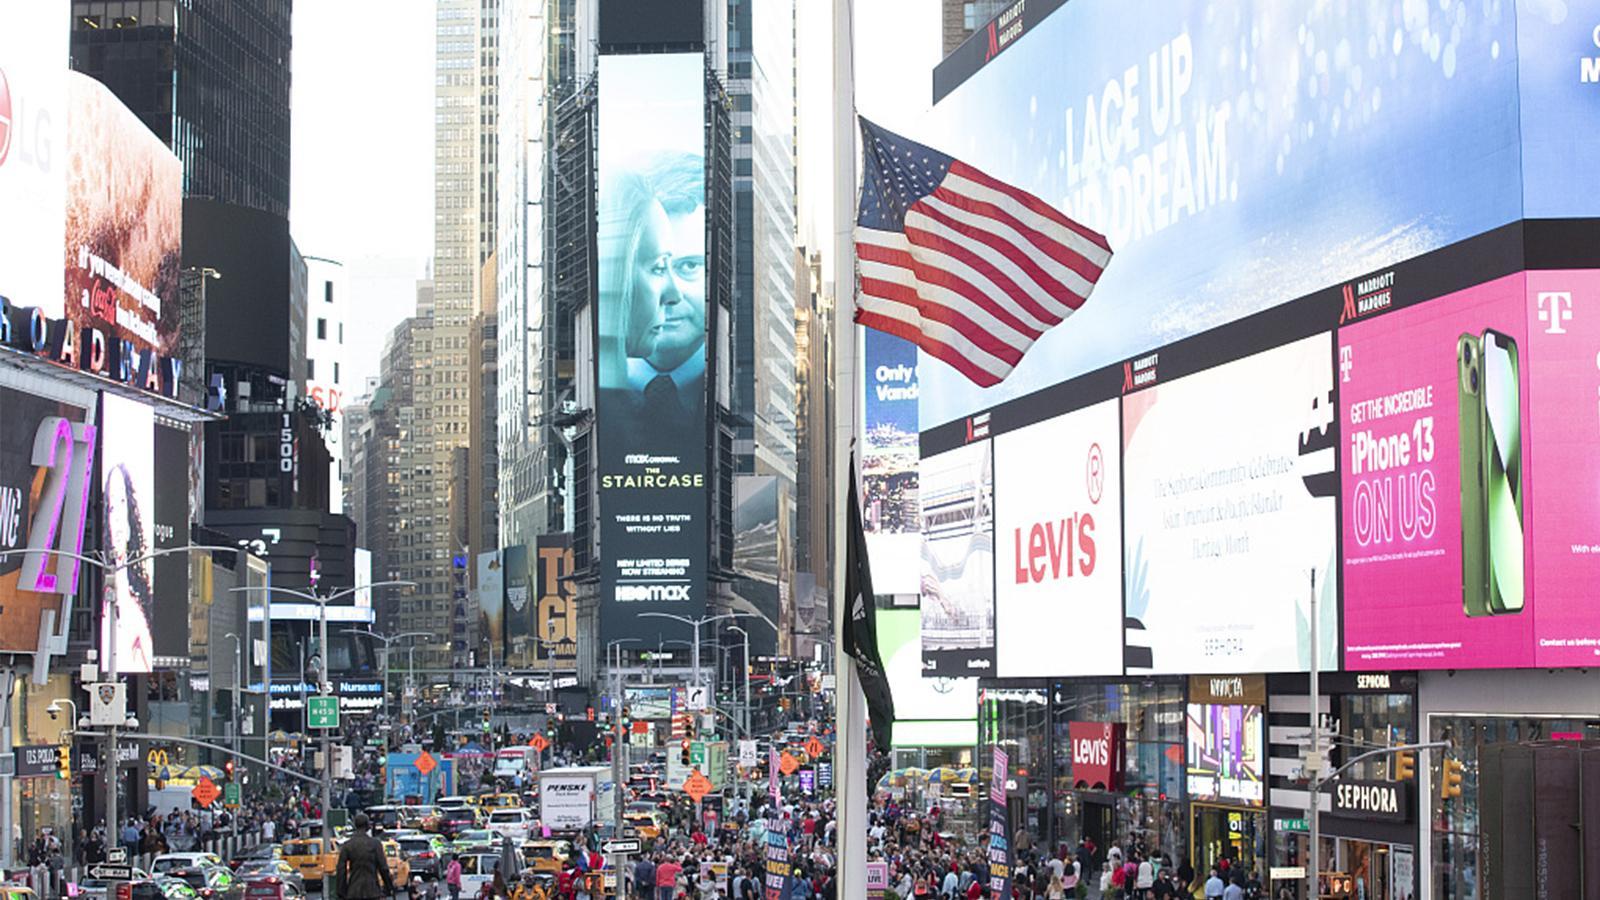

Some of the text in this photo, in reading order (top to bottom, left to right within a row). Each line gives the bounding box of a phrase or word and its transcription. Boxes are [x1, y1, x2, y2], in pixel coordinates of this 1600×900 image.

[1066, 32, 1192, 187] LACE UP
[1358, 272, 1396, 295] MARRIOTT
[1358, 291, 1392, 314] MARQUIS
[876, 364, 913, 384] Only
[1351, 385, 1433, 424] GET THE INCREDIBLE
[281, 413, 292, 472] 1500
[1352, 416, 1435, 475] iPhone 13
[602, 474, 704, 488] STAIRCASE
[1353, 469, 1436, 547] ON US
[666, 514, 691, 522] TRUTH
[626, 525, 661, 533] WITHOUT
[616, 559, 635, 567] NEW
[621, 568, 641, 576] NOW
[1540, 638, 1566, 647] Contact
[1357, 674, 1390, 689] SEPHORA
[38, 748, 54, 763] POLO
[742, 750, 755, 759] 25
[547, 784, 587, 792] PENSKE
[1337, 784, 1398, 814] SEPHORA
[867, 874, 882, 884] LIVE
